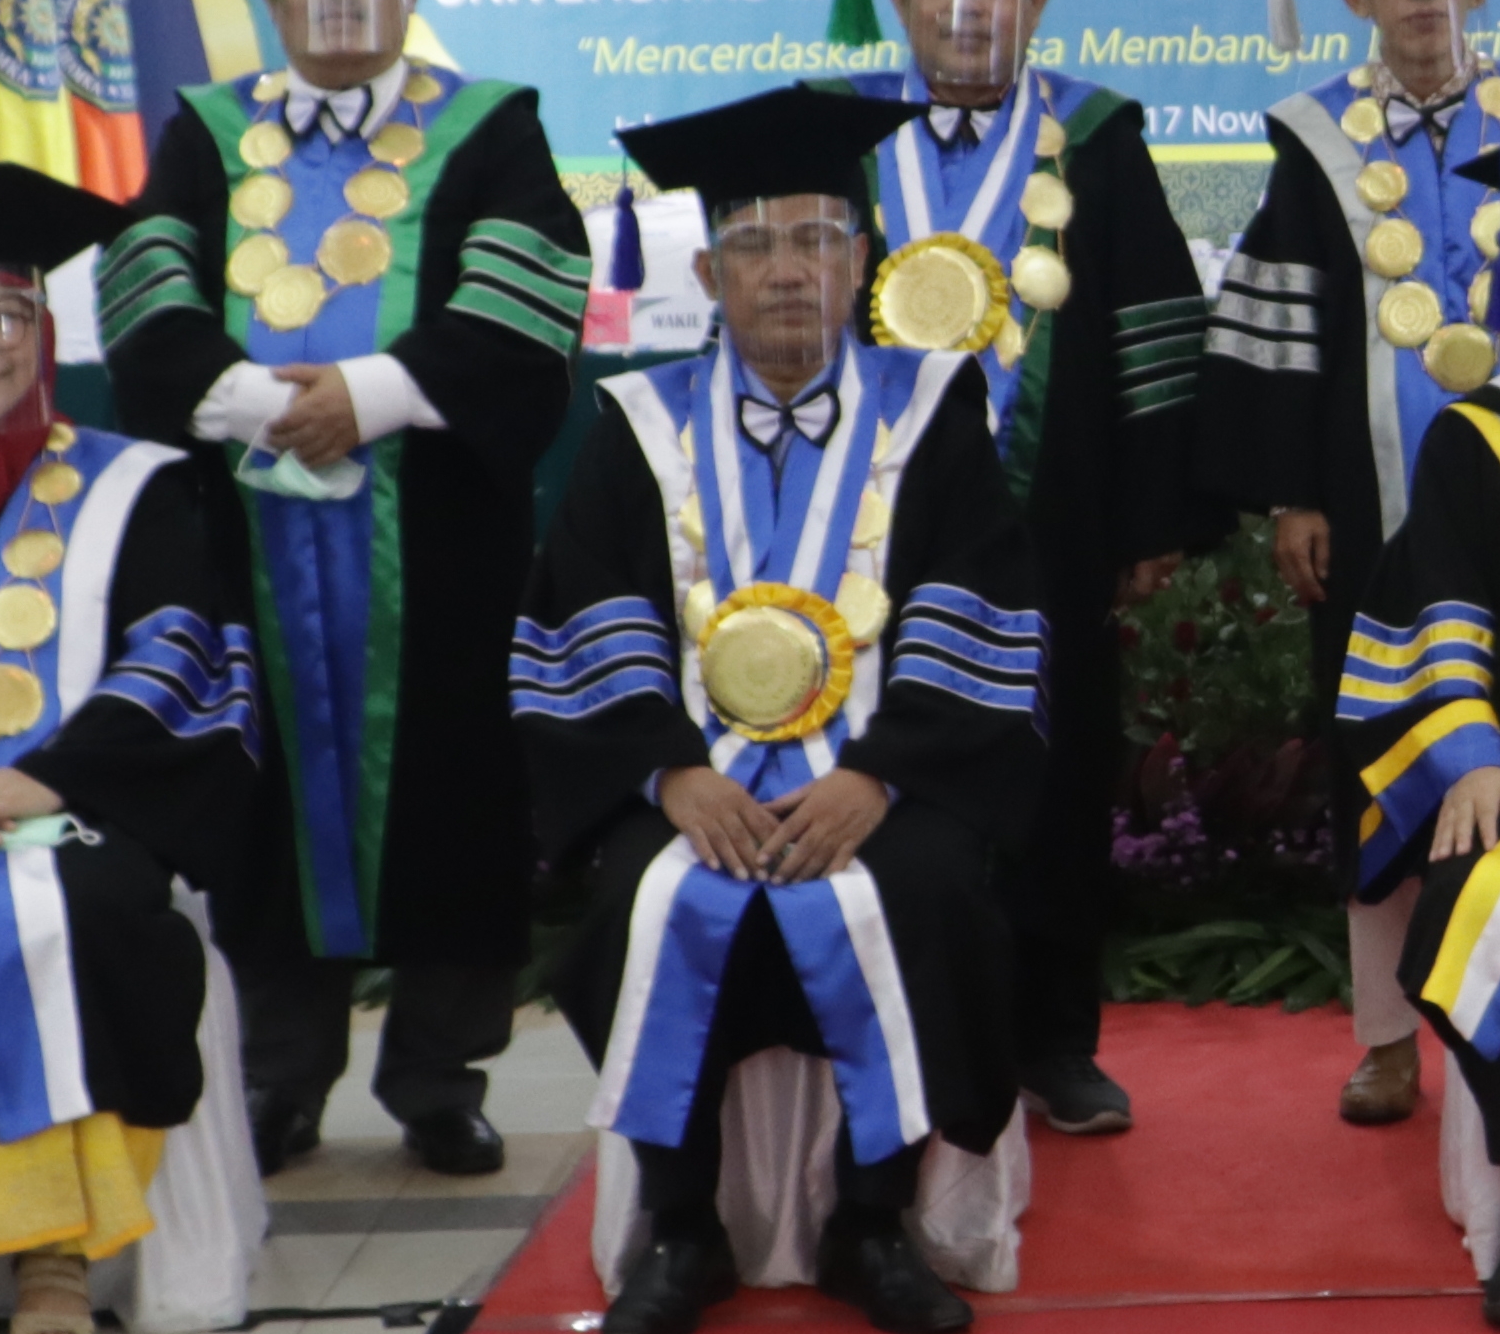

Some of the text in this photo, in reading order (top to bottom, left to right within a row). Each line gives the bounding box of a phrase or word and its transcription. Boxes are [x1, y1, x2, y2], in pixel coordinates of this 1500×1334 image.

[1079, 24, 1349, 72] Membangun
[1144, 106, 1182, 136] 17
[651, 311, 704, 329] WAKIL
